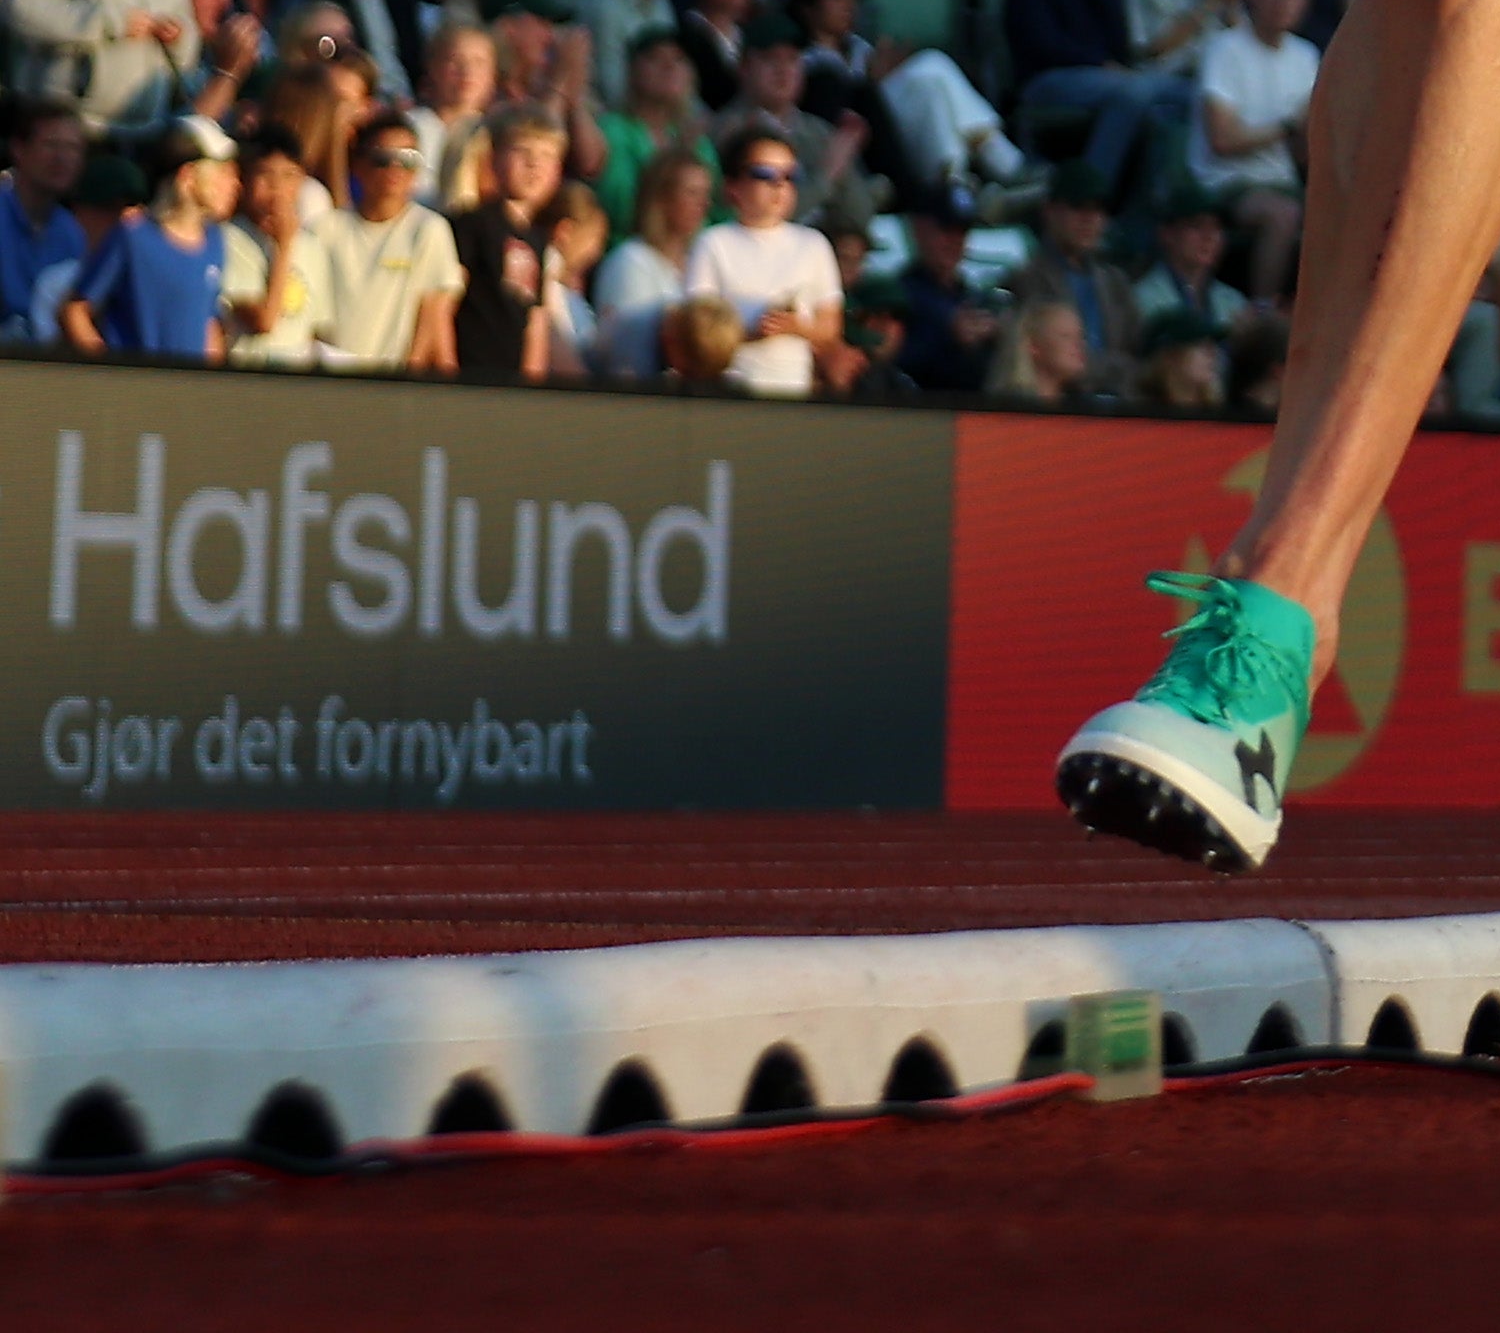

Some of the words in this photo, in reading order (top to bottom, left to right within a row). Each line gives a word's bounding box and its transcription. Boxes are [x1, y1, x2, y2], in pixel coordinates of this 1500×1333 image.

[48, 429, 734, 645] Hafslund
[43, 695, 182, 802] Gjør
[196, 695, 300, 784] det
[316, 695, 593, 804] fornybart
